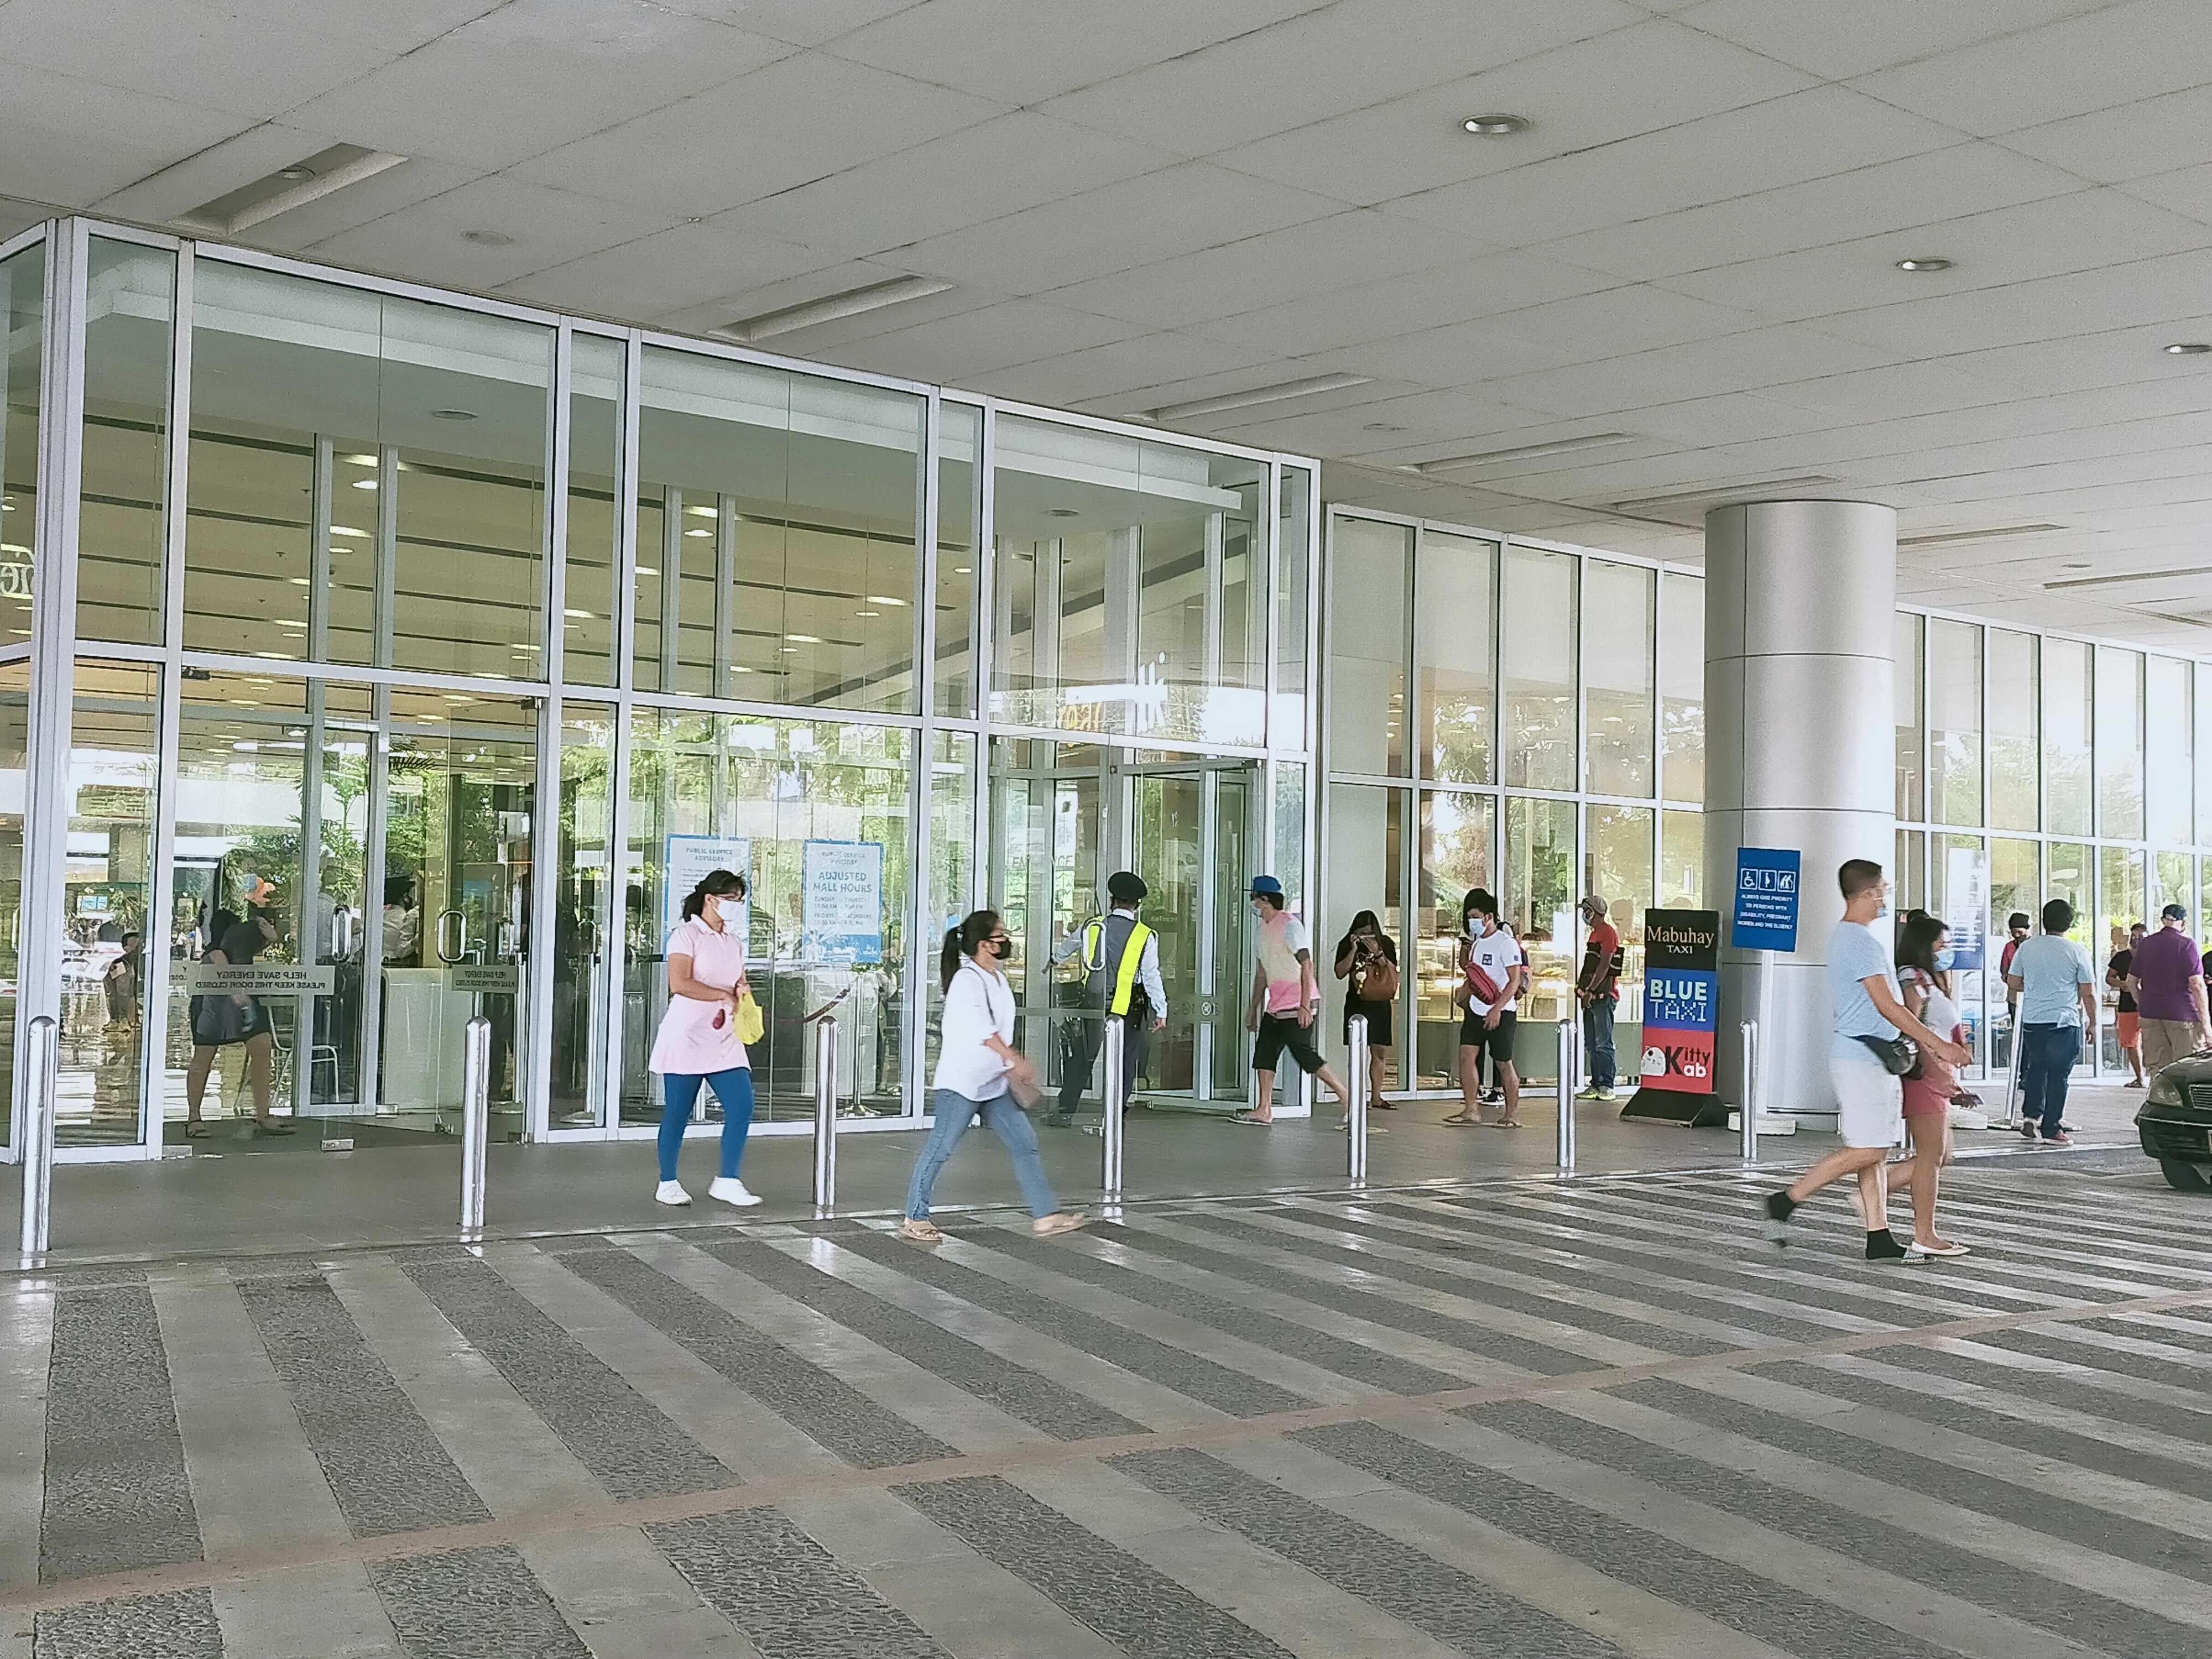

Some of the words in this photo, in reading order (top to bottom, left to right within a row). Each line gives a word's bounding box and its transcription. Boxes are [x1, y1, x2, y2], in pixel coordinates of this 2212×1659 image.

[818, 871, 867, 881] ADJUSTED
[813, 883, 837, 892] MALL
[841, 883, 872, 893] HOURS
[1647, 925, 1714, 948] Mabuhay
[1666, 945, 1693, 954] TAXI
[1650, 979, 1707, 1001] BLUE
[1650, 999, 1707, 1022] TAXI
[1665, 1045, 1710, 1074] Kitty
